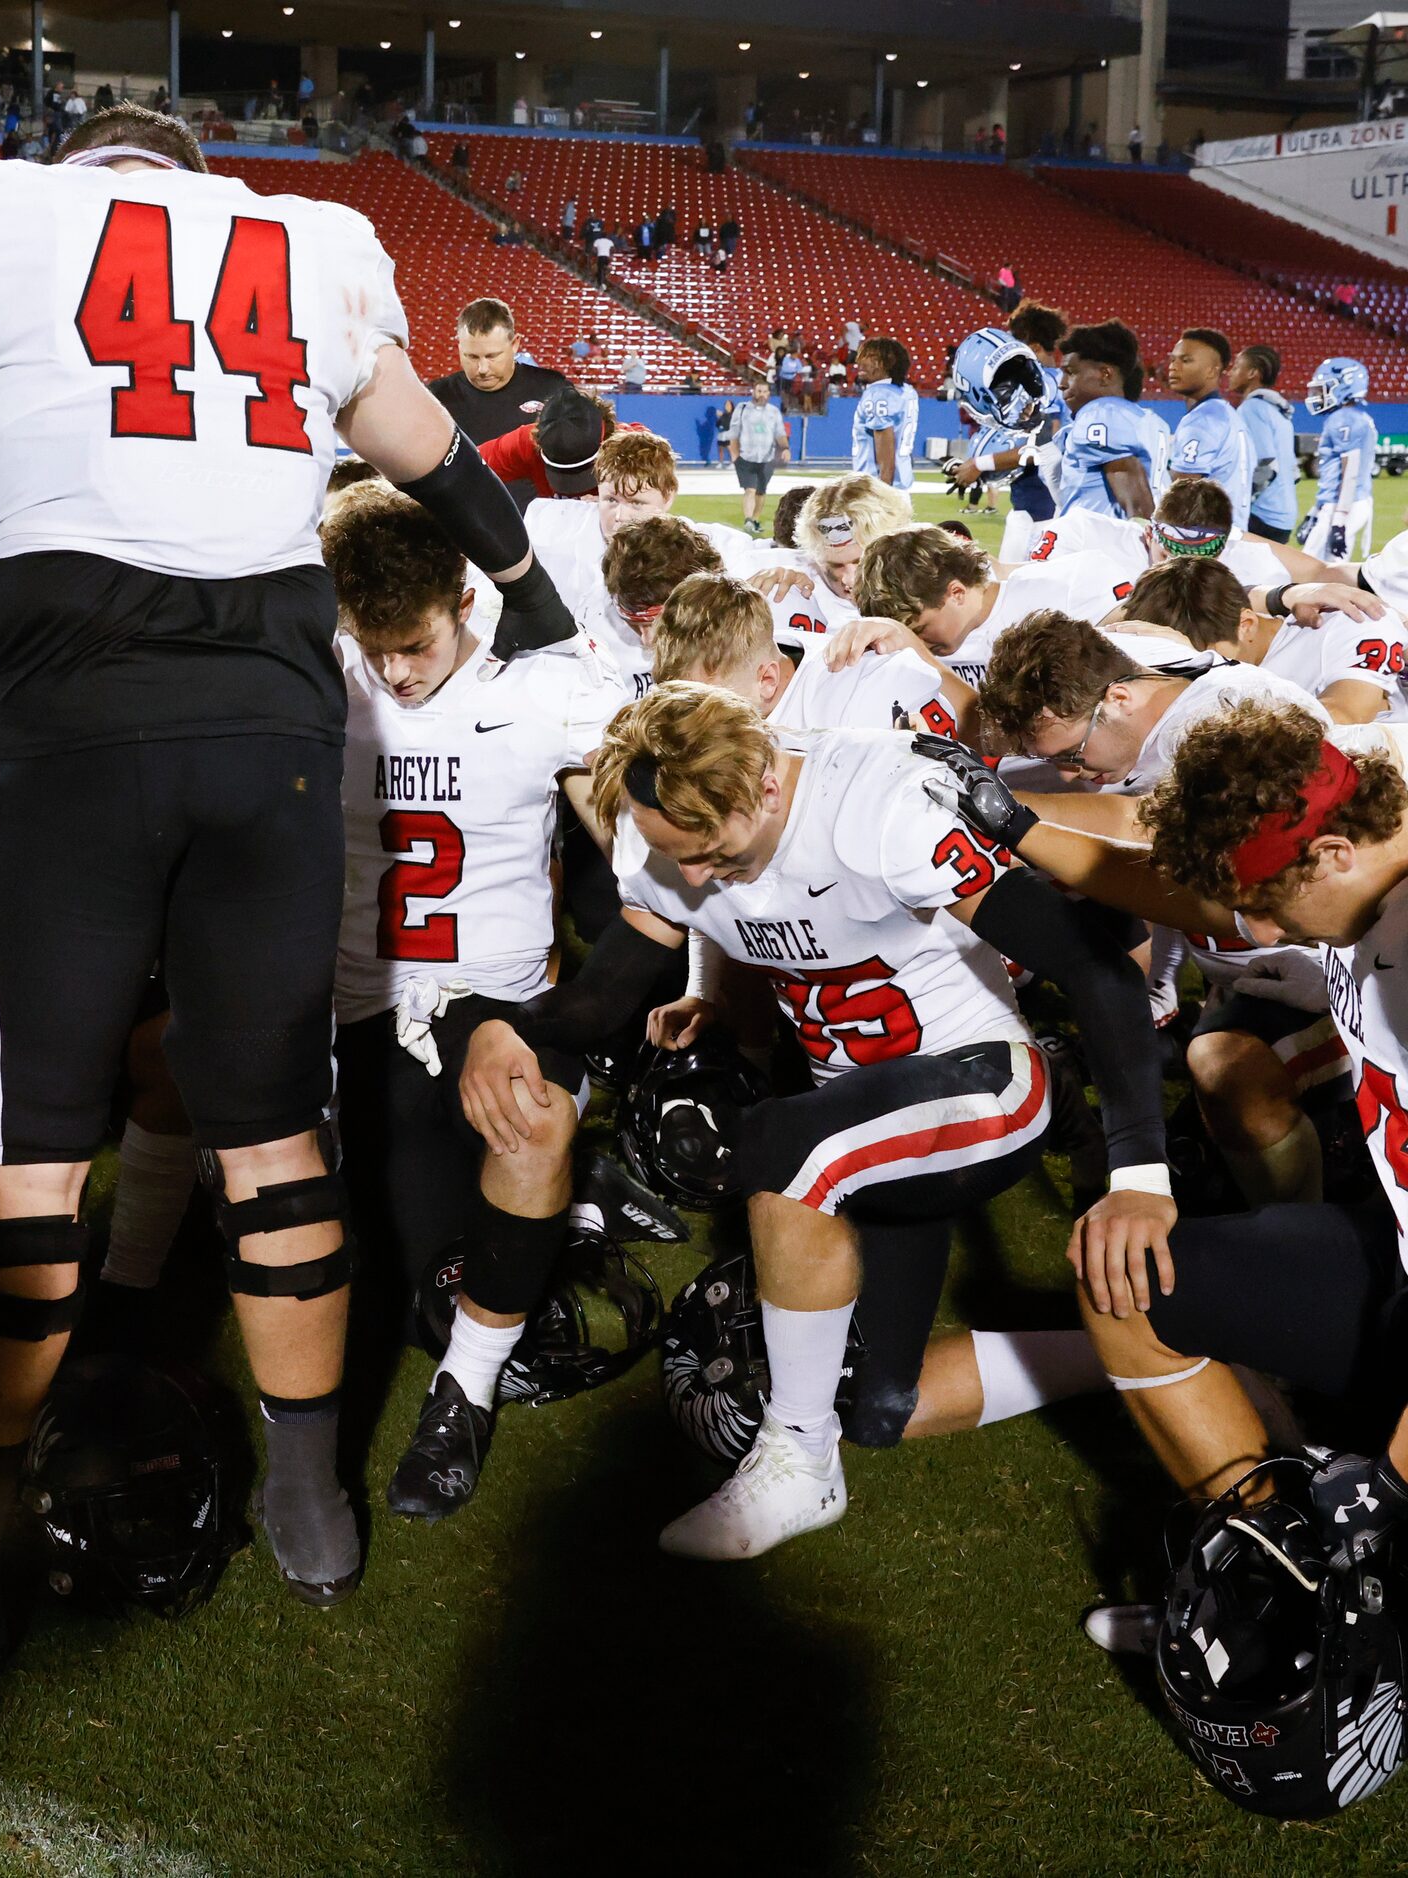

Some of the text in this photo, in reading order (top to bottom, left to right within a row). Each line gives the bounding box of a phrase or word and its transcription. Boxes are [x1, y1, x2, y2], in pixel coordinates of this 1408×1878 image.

[1286, 132, 1343, 153] ULTRA
[1350, 122, 1406, 146] ZONE
[74, 198, 313, 456] 44
[864, 400, 889, 418] 26
[1086, 422, 1108, 448] 9
[1339, 425, 1351, 442] 7
[1182, 438, 1200, 464] 4
[374, 755, 462, 802] ARGYLE
[375, 808, 466, 964] 2
[734, 918, 829, 961] ARGYLE
[620, 1202, 678, 1240] BLUR
